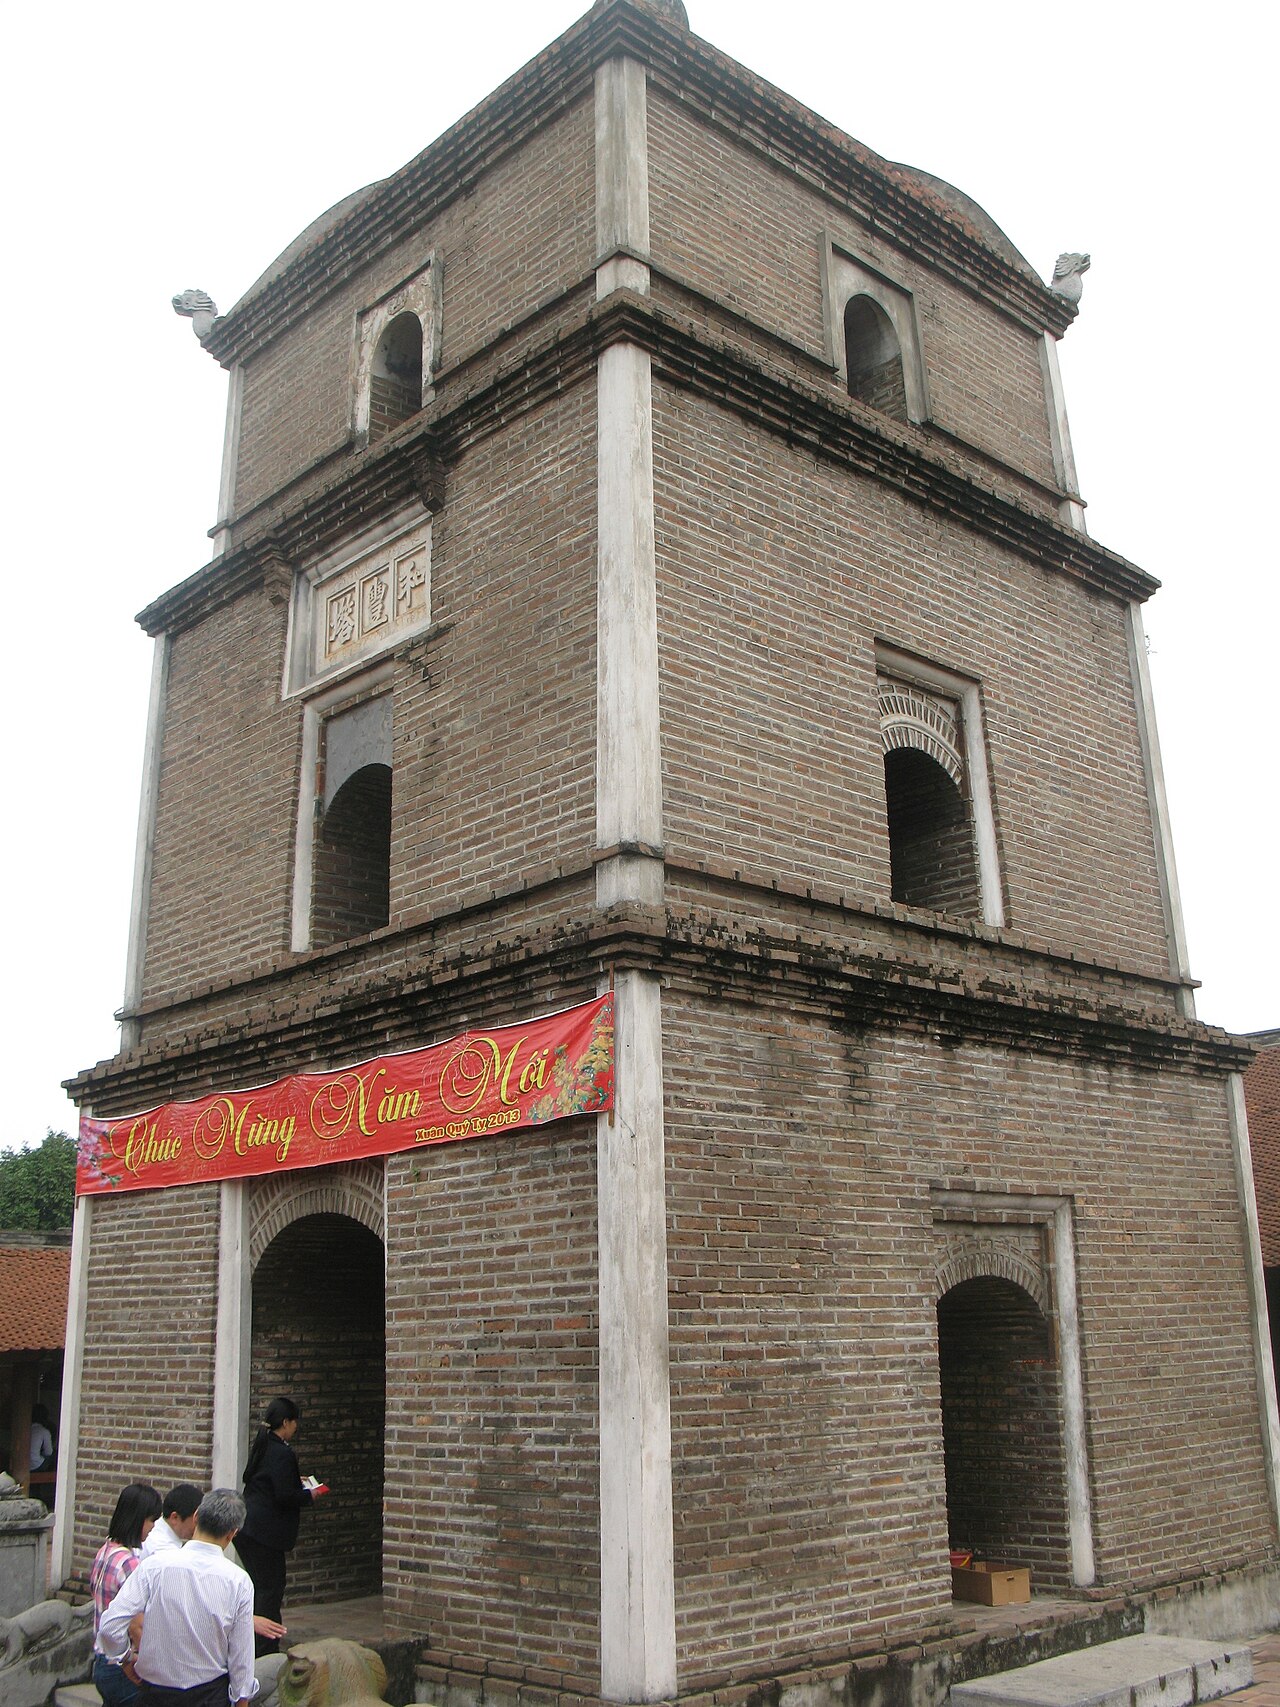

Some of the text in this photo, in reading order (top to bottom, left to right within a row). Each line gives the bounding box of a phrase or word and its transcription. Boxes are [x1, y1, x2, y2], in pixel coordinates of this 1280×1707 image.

[109, 1036, 552, 1178] Chúc Mừng Năm Mới
[415, 1127, 445, 1142] Xuân
[445, 1119, 471, 1138] Quý
[488, 1108, 521, 1128] 2013
